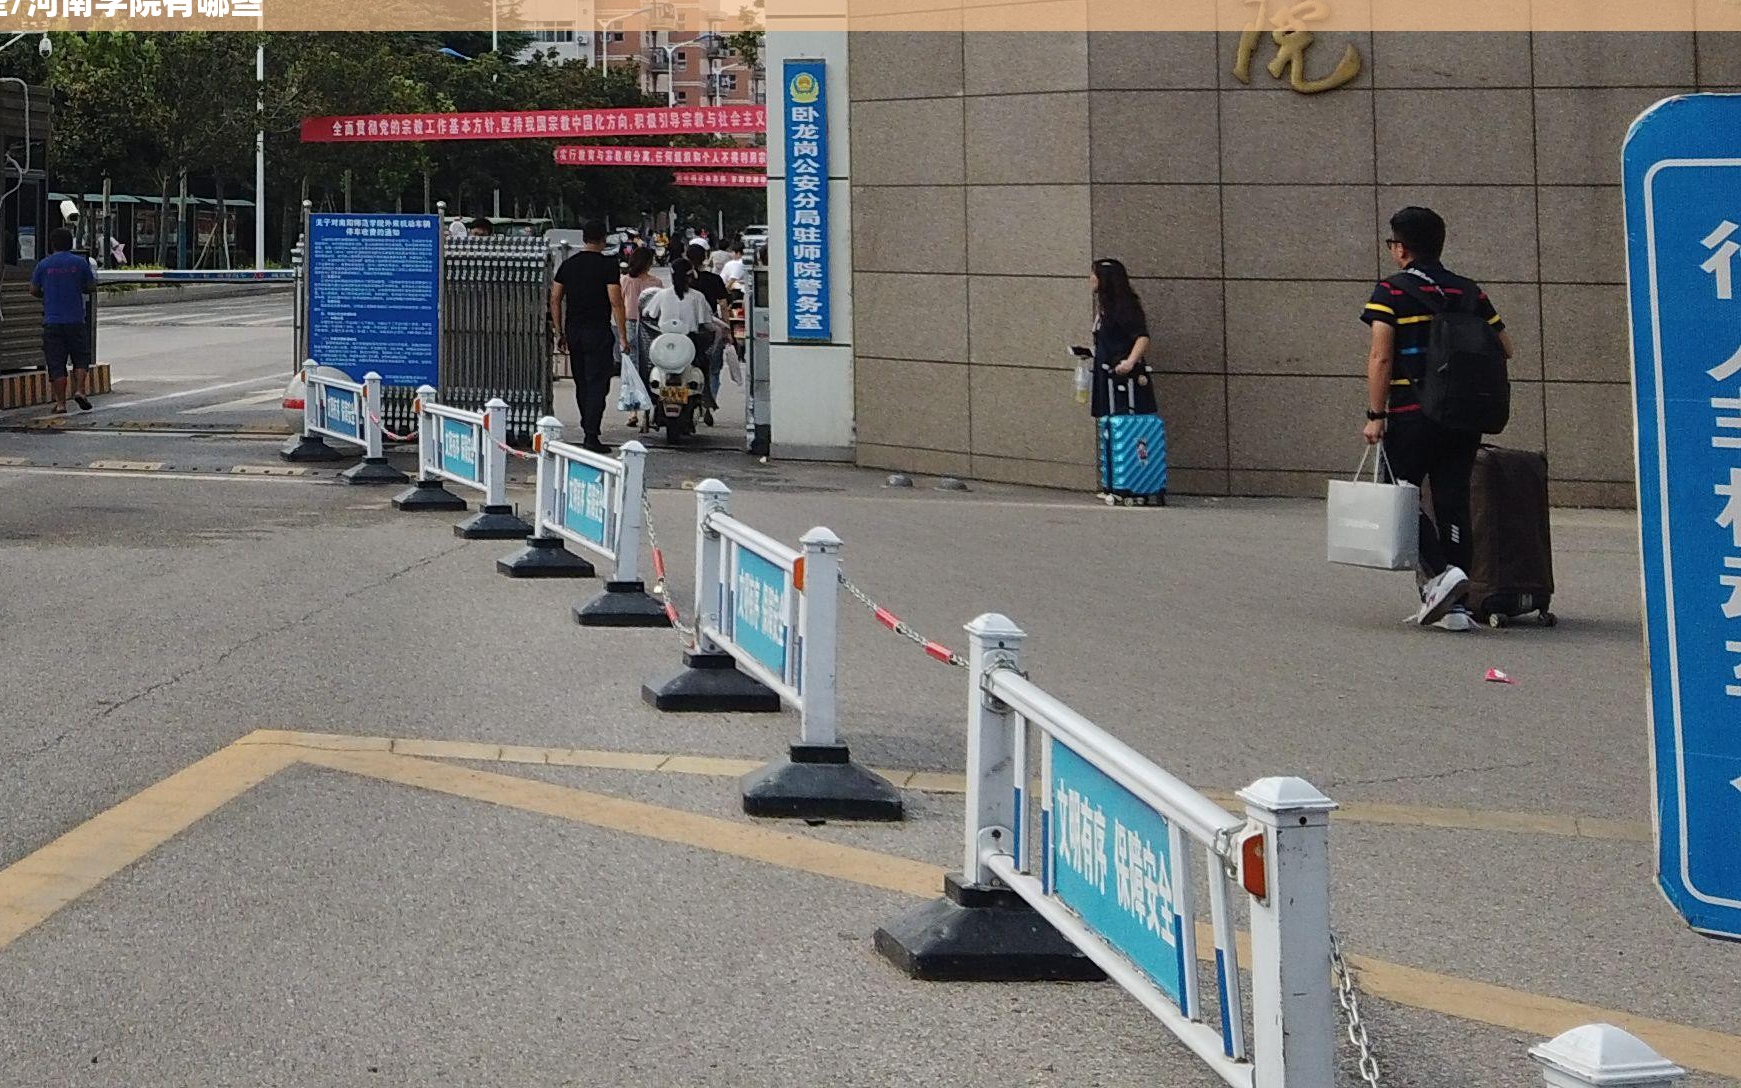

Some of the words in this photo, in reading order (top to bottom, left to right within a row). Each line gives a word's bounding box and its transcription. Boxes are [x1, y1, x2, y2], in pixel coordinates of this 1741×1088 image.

[790, 106, 823, 330] 卧龙岗公安分局驻师院警务室
[1056, 778, 1108, 896] 文明有序
